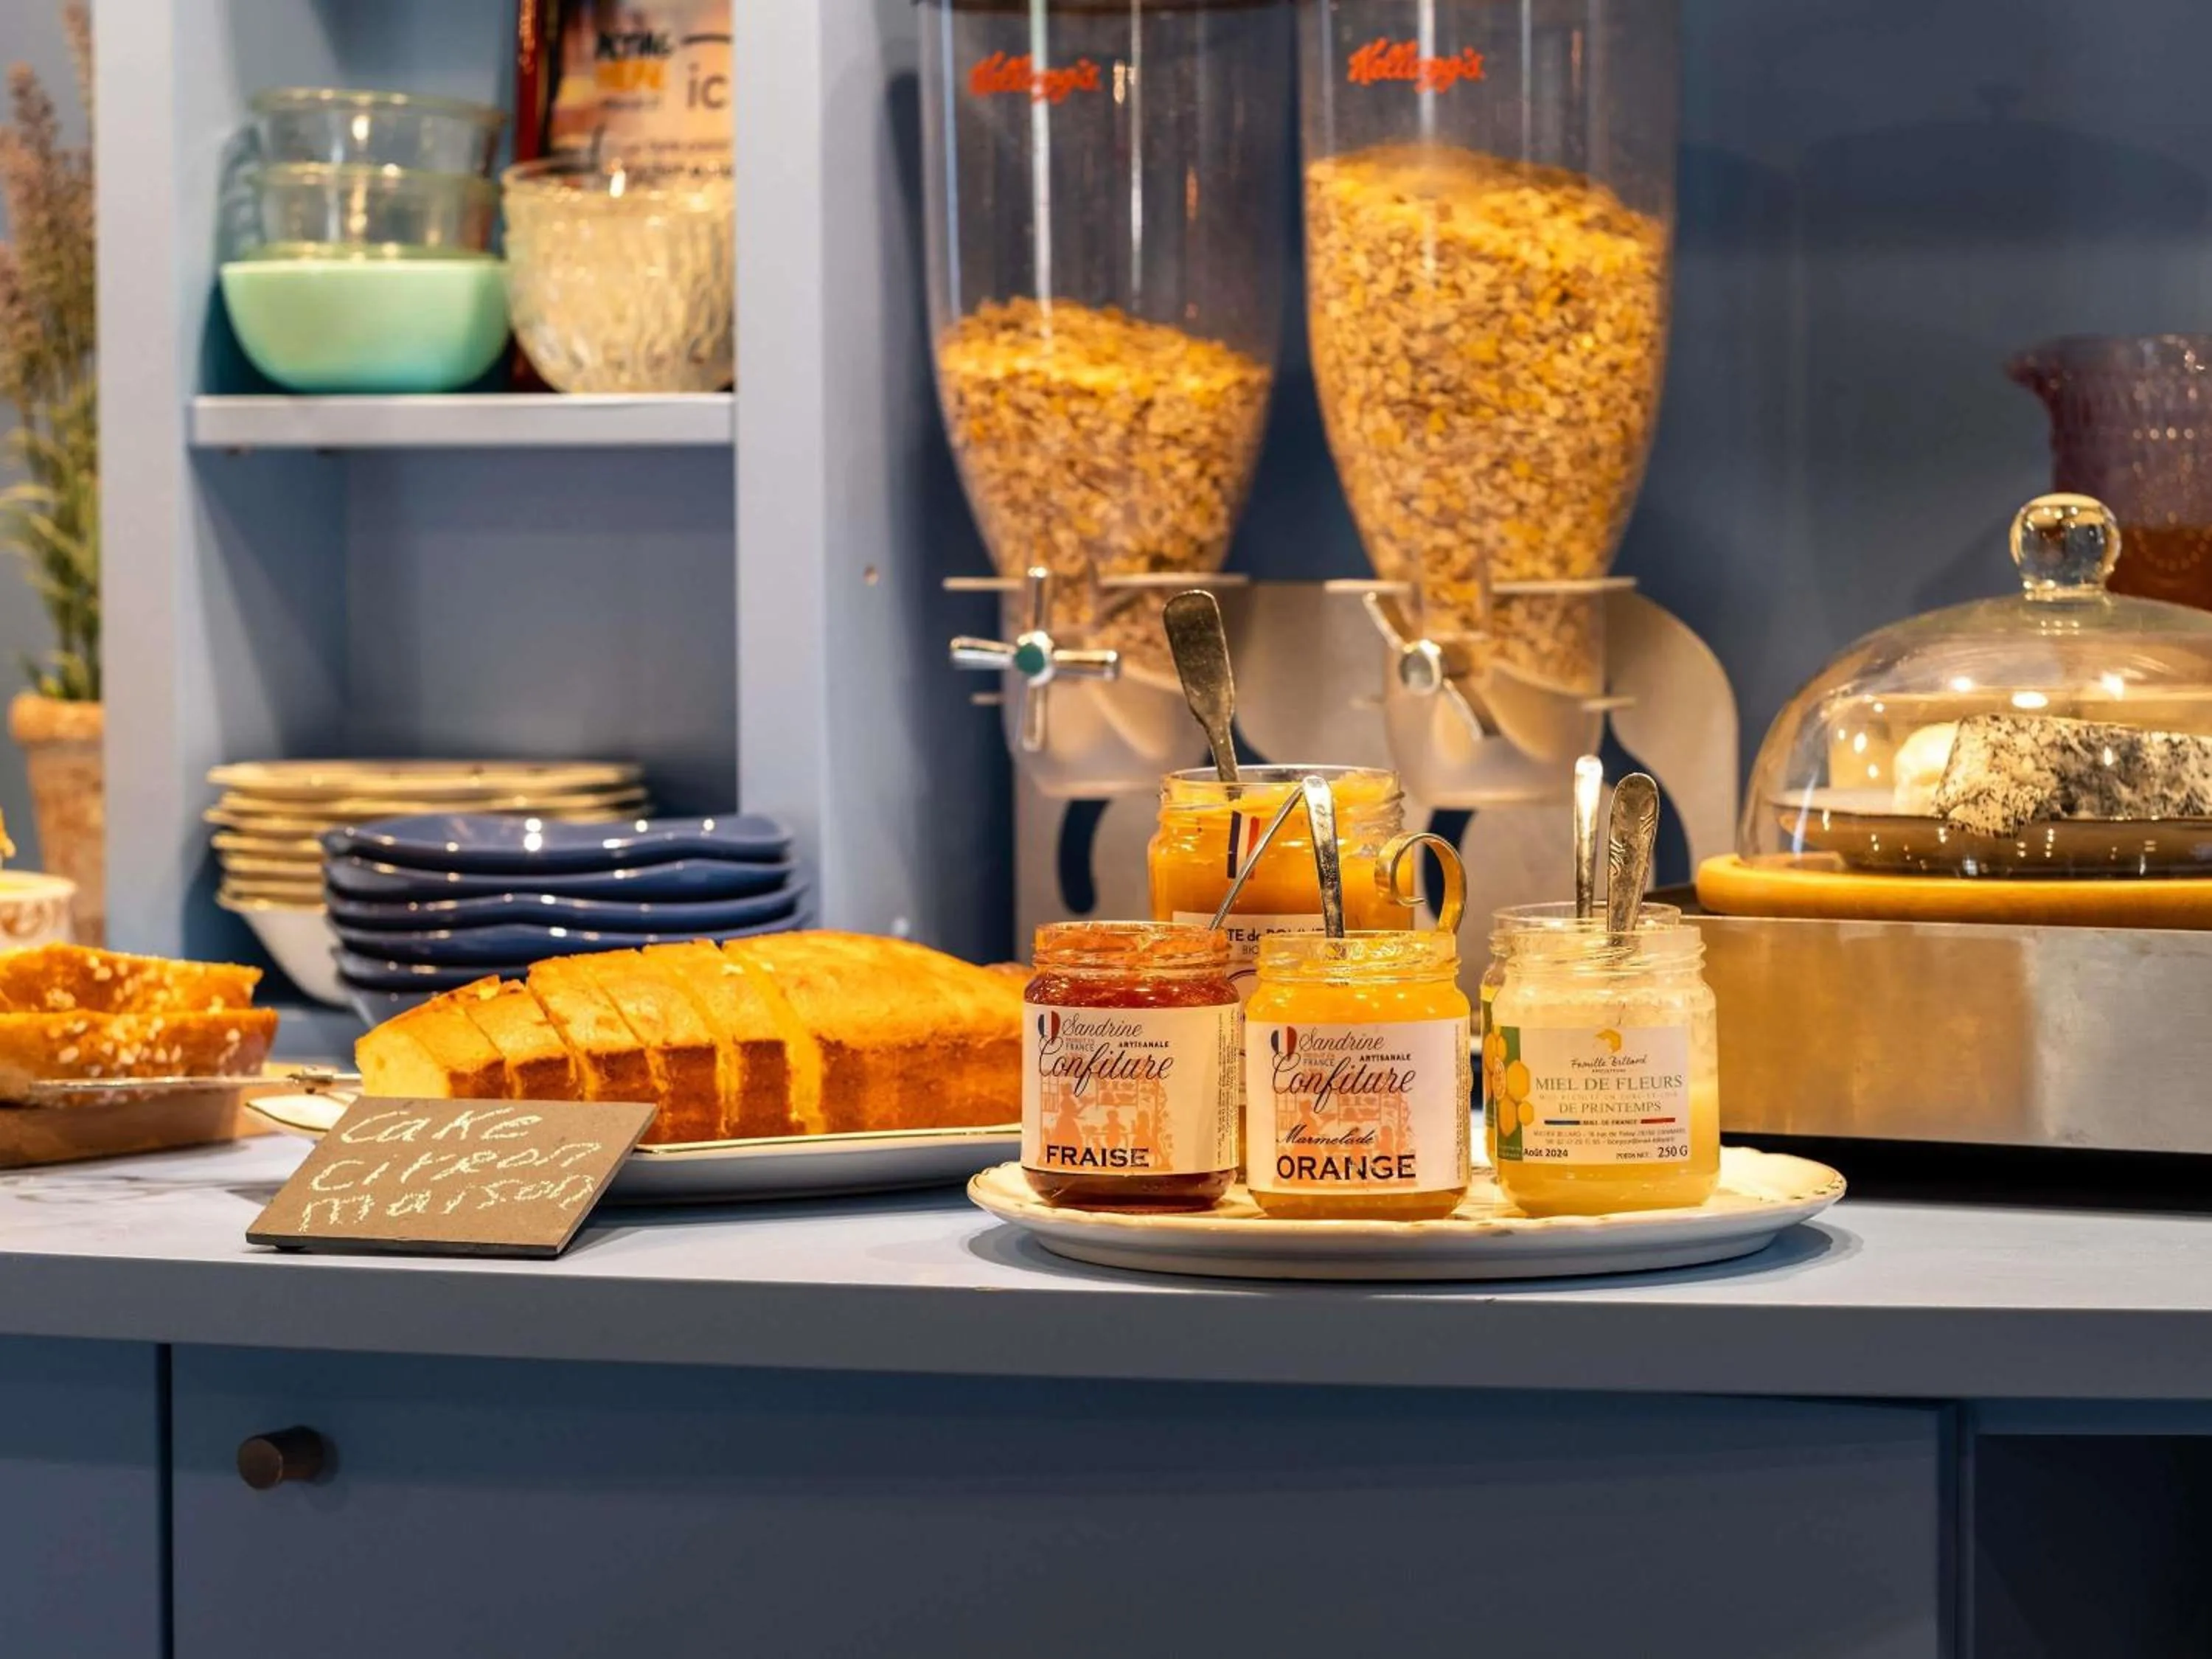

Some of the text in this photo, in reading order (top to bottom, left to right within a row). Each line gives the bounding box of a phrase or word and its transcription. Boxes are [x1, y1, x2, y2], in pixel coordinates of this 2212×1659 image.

[1347, 37, 1486, 94] Kellogg's
[1062, 1013, 1143, 1037] Sandrine
[1065, 1043, 1095, 1051] FRANCE
[1298, 1026, 1385, 1051] Sandrine
[1038, 1036, 1175, 1097] Confiture
[1303, 1059, 1335, 1068] FRANCE
[1359, 1053, 1411, 1062] ARTISANALE
[1271, 1051, 1416, 1114] Confiture
[1536, 1075, 1683, 1091] MIEL DE FLEURS
[1559, 1102, 1661, 1113] DE PRINTEMPS
[1276, 1123, 1377, 1144] Marmelade
[1046, 1144, 1150, 1168] FRAISE
[1545, 1149, 1568, 1157] 2024
[1658, 1147, 1677, 1158] 250
[1680, 1146, 1688, 1156] G
[1277, 1155, 1416, 1180] ORANGE
